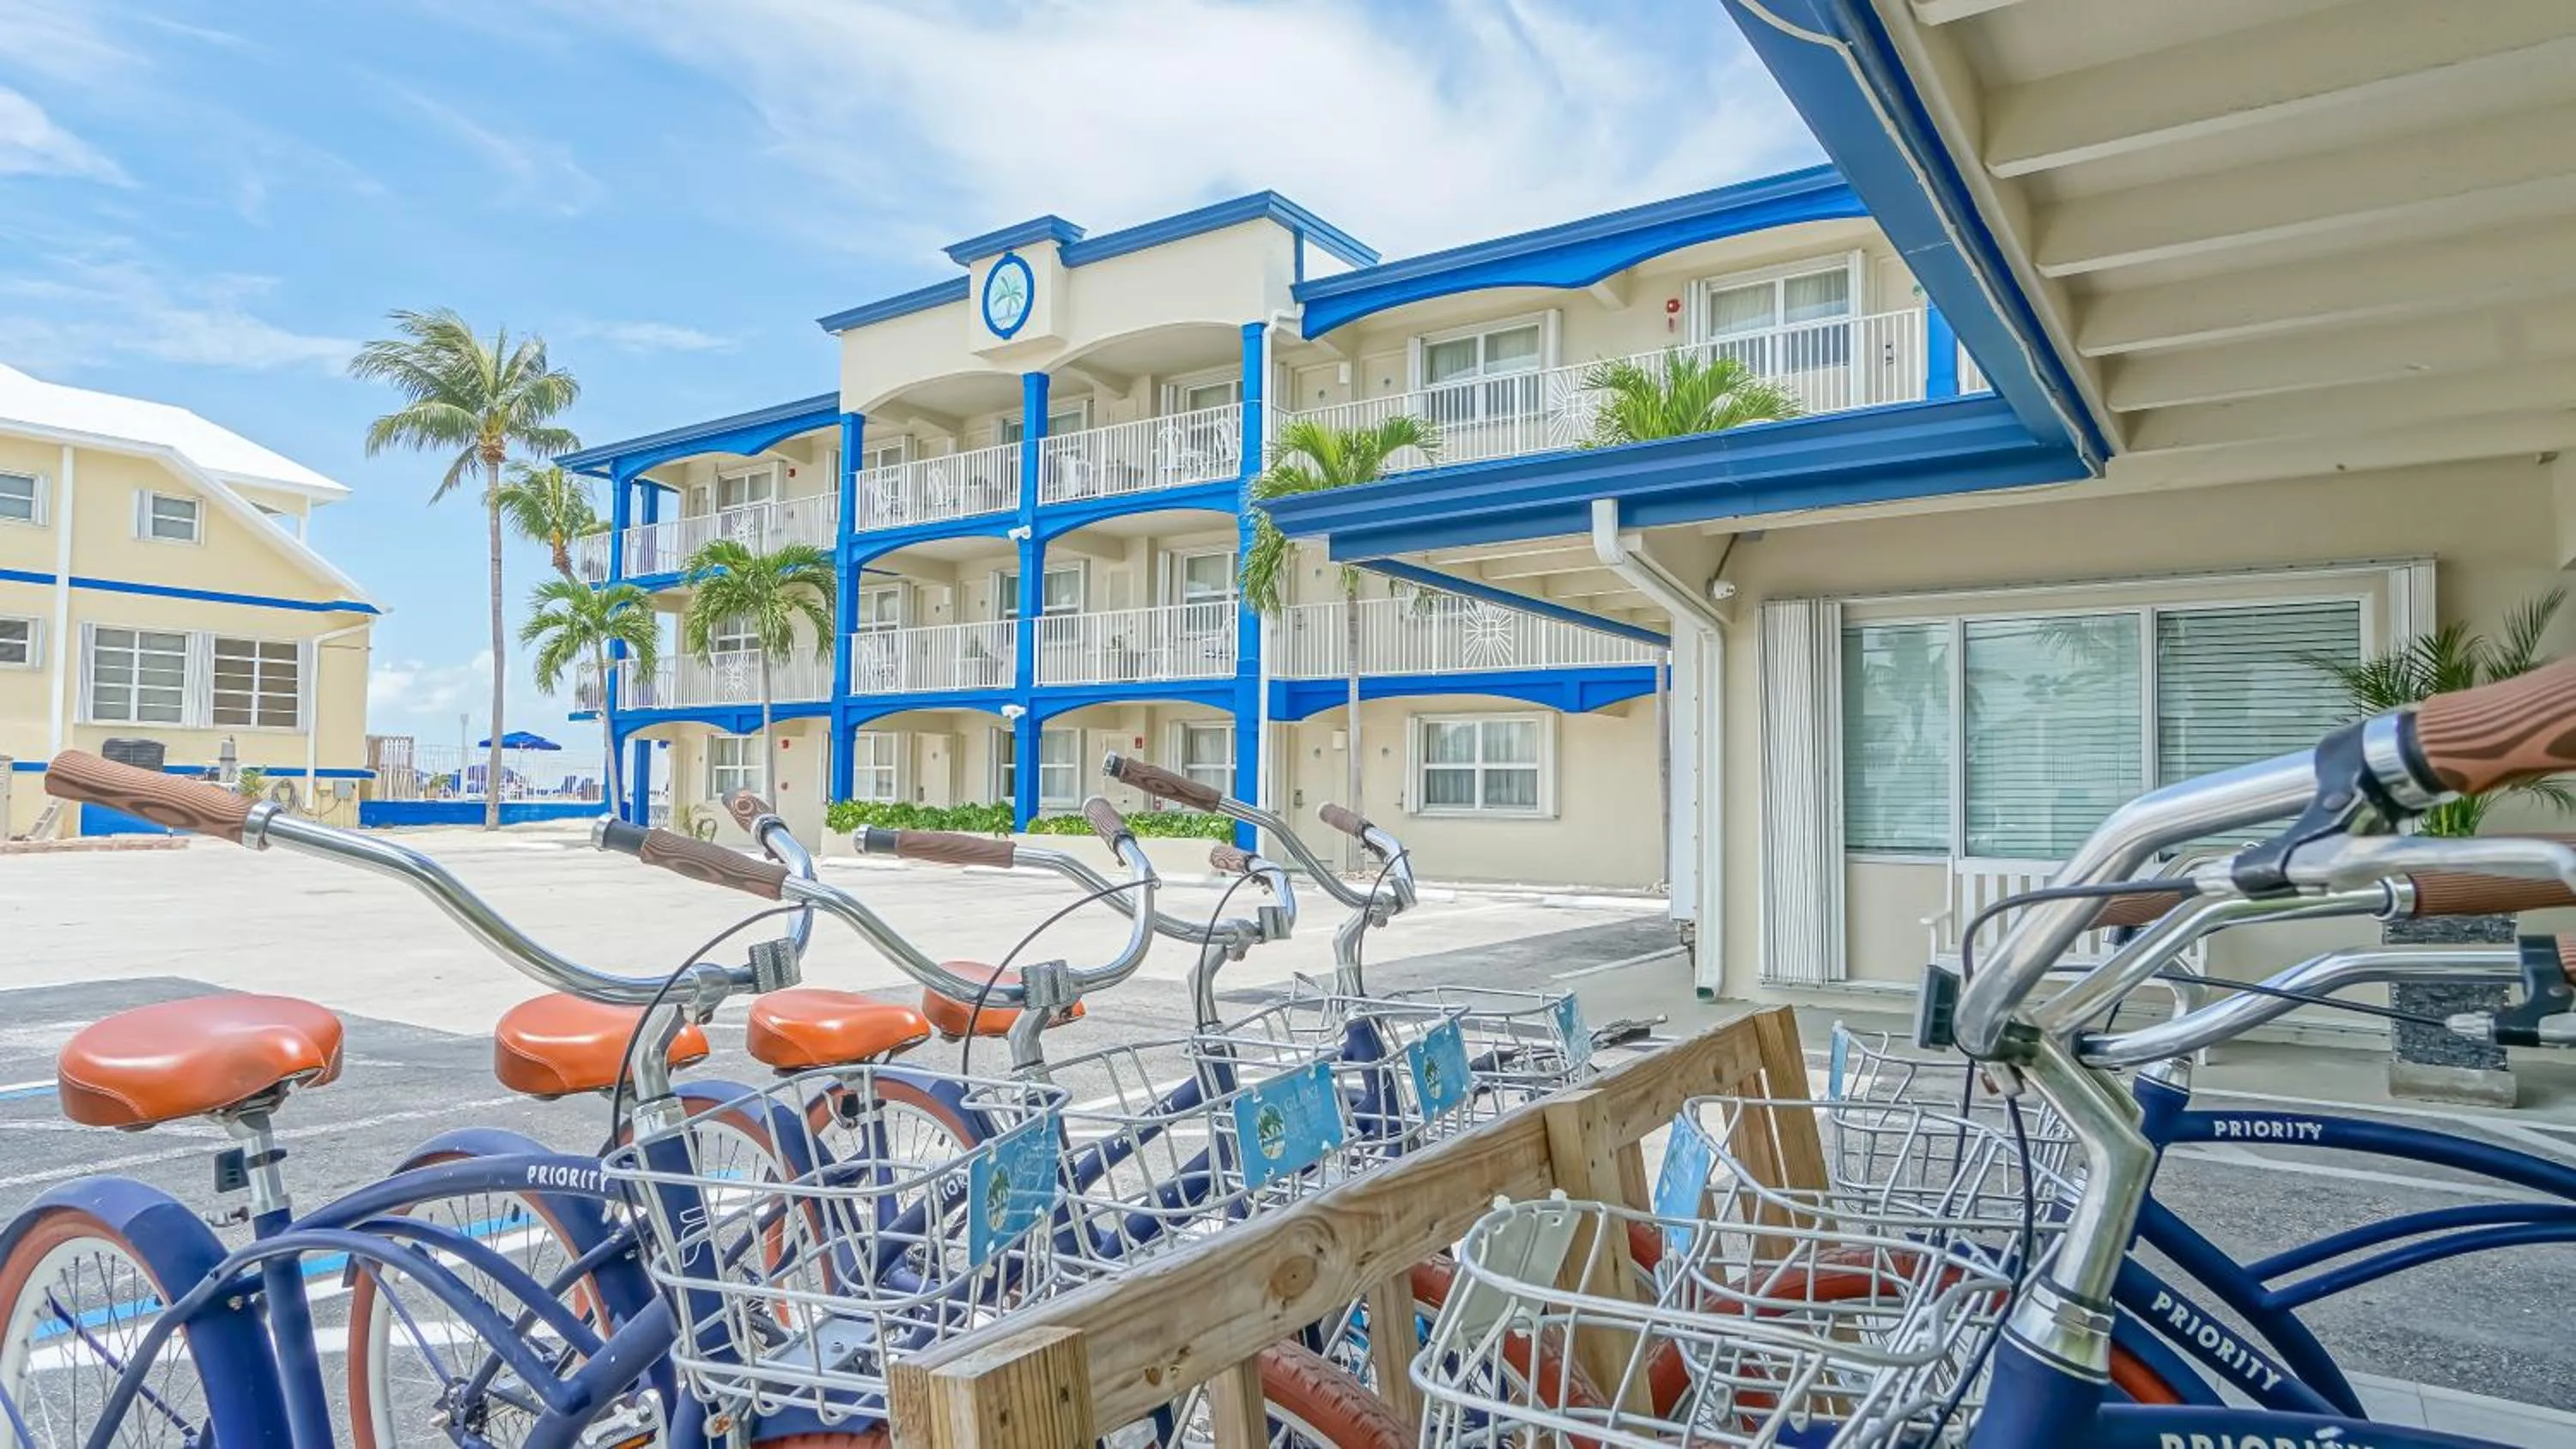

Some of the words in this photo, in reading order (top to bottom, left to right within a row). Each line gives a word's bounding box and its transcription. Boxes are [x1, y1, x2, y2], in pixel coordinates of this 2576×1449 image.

[2213, 1119, 2323, 1140] PRIORITY
[526, 1164, 611, 1191] PRIORITY
[2150, 1290, 2281, 1391] PRIORITY
